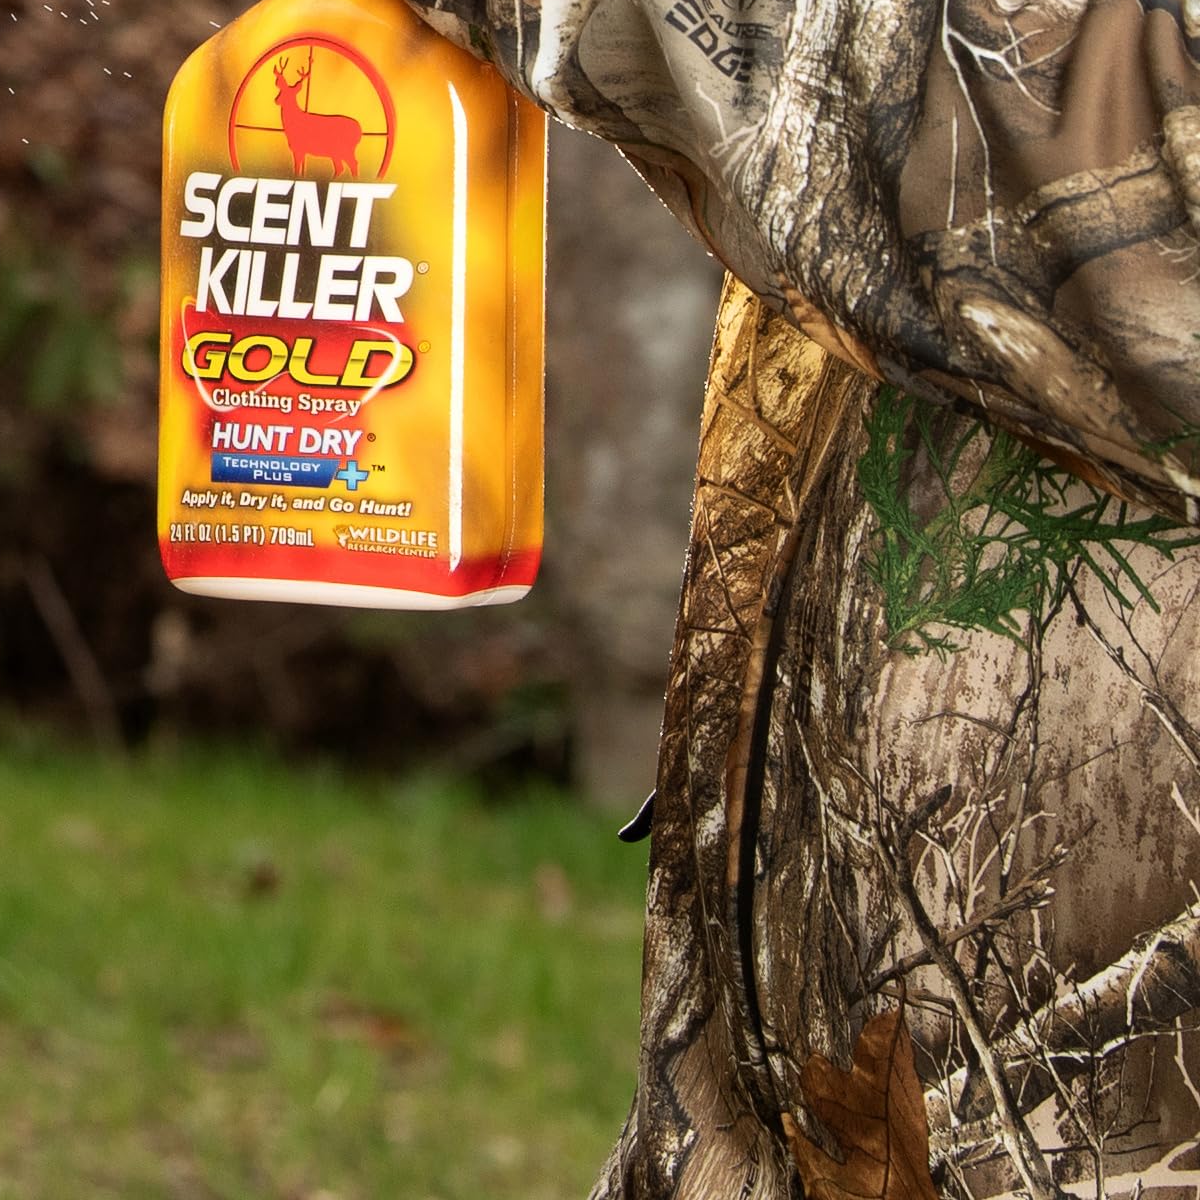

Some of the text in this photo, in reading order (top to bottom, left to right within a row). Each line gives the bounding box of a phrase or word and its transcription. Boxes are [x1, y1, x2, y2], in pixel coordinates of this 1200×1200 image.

[179, 171, 398, 249] SCENT
[195, 246, 415, 323] KILLER
[182, 331, 415, 389] GOLD
[212, 389, 361, 416] Clothing Spray
[212, 422, 363, 456] HUNT DRY
[182, 490, 412, 517] Apply it, Dry it, and Go Hunt!
[170, 523, 314, 547] 24 FL OZ (1.5 PT) 709mL
[348, 525, 438, 548] WILDLIFE
[347, 542, 438, 558] RESEARCH CENTER
